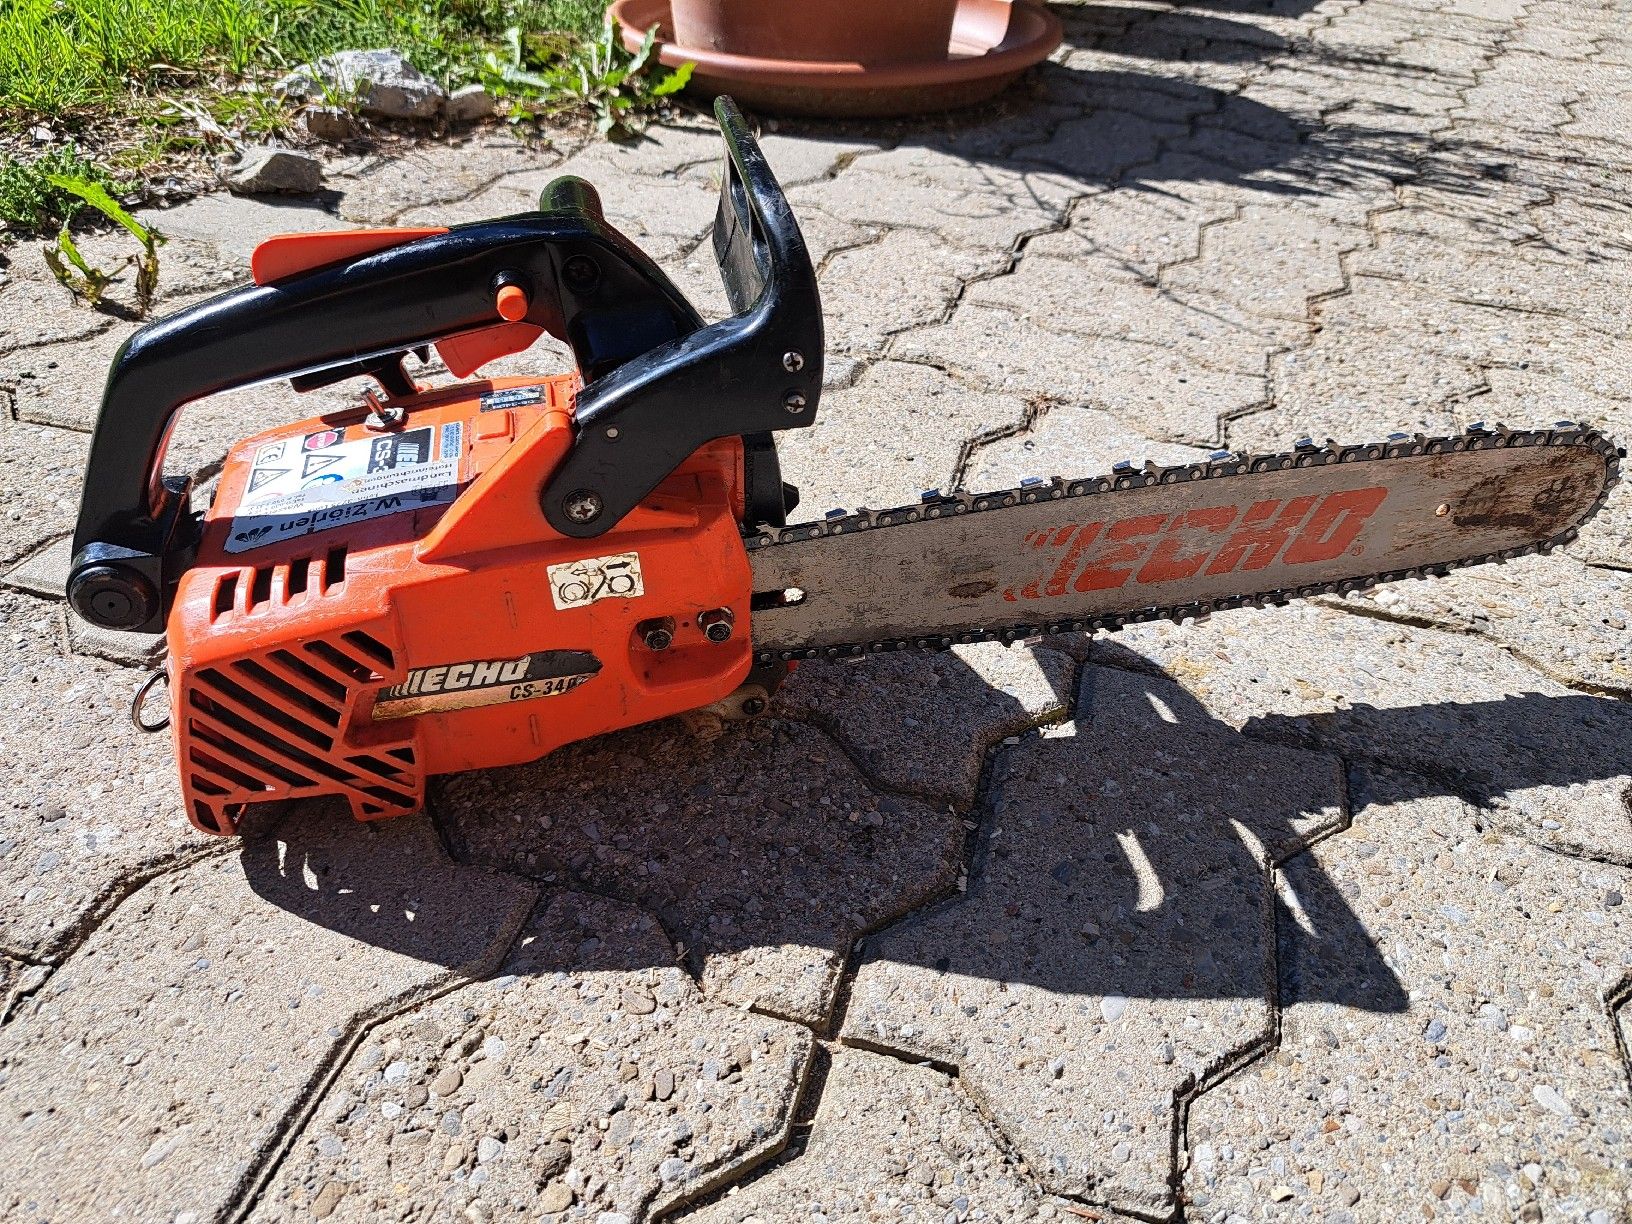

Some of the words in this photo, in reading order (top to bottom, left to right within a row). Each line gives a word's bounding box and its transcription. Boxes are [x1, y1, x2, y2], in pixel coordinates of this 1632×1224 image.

[352, 471, 452, 494] Landmaschinen
[280, 496, 402, 532] W.Ziörjen
[1073, 487, 1389, 594] ECHO
[420, 656, 531, 693] ECHO
